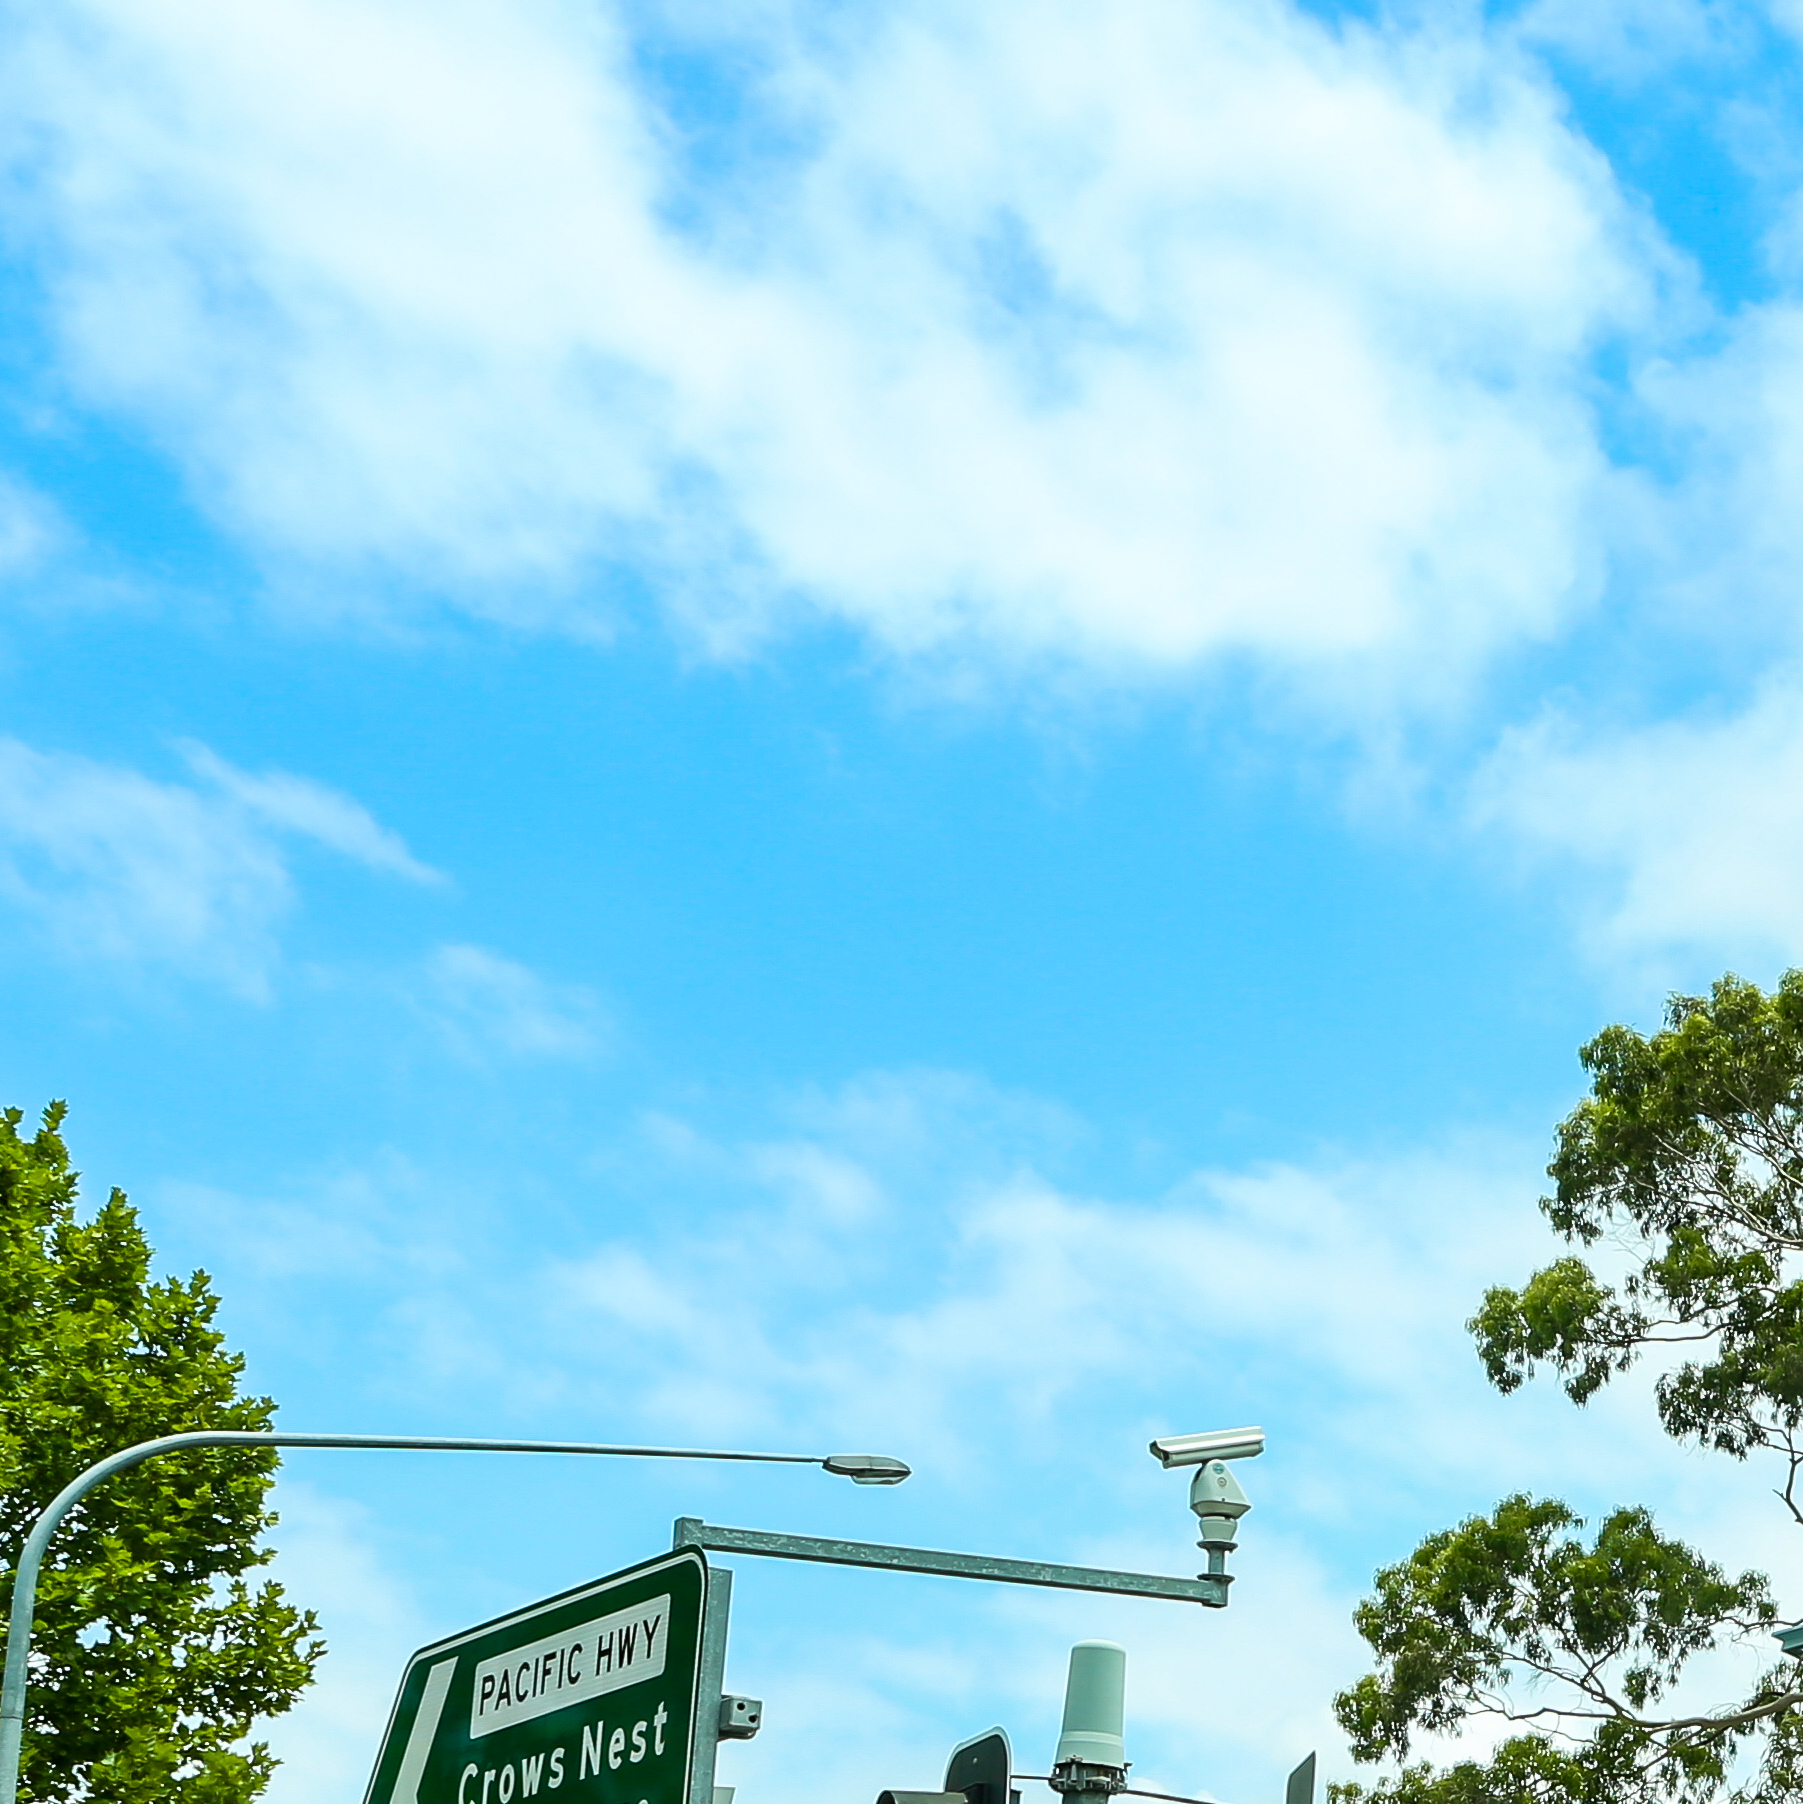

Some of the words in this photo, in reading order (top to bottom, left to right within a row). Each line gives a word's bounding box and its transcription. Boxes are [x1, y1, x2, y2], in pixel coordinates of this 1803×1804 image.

[479, 1643, 583, 1716] PACIFIC
[595, 1614, 662, 1677] HWY
[579, 1701, 668, 1780] Nest
